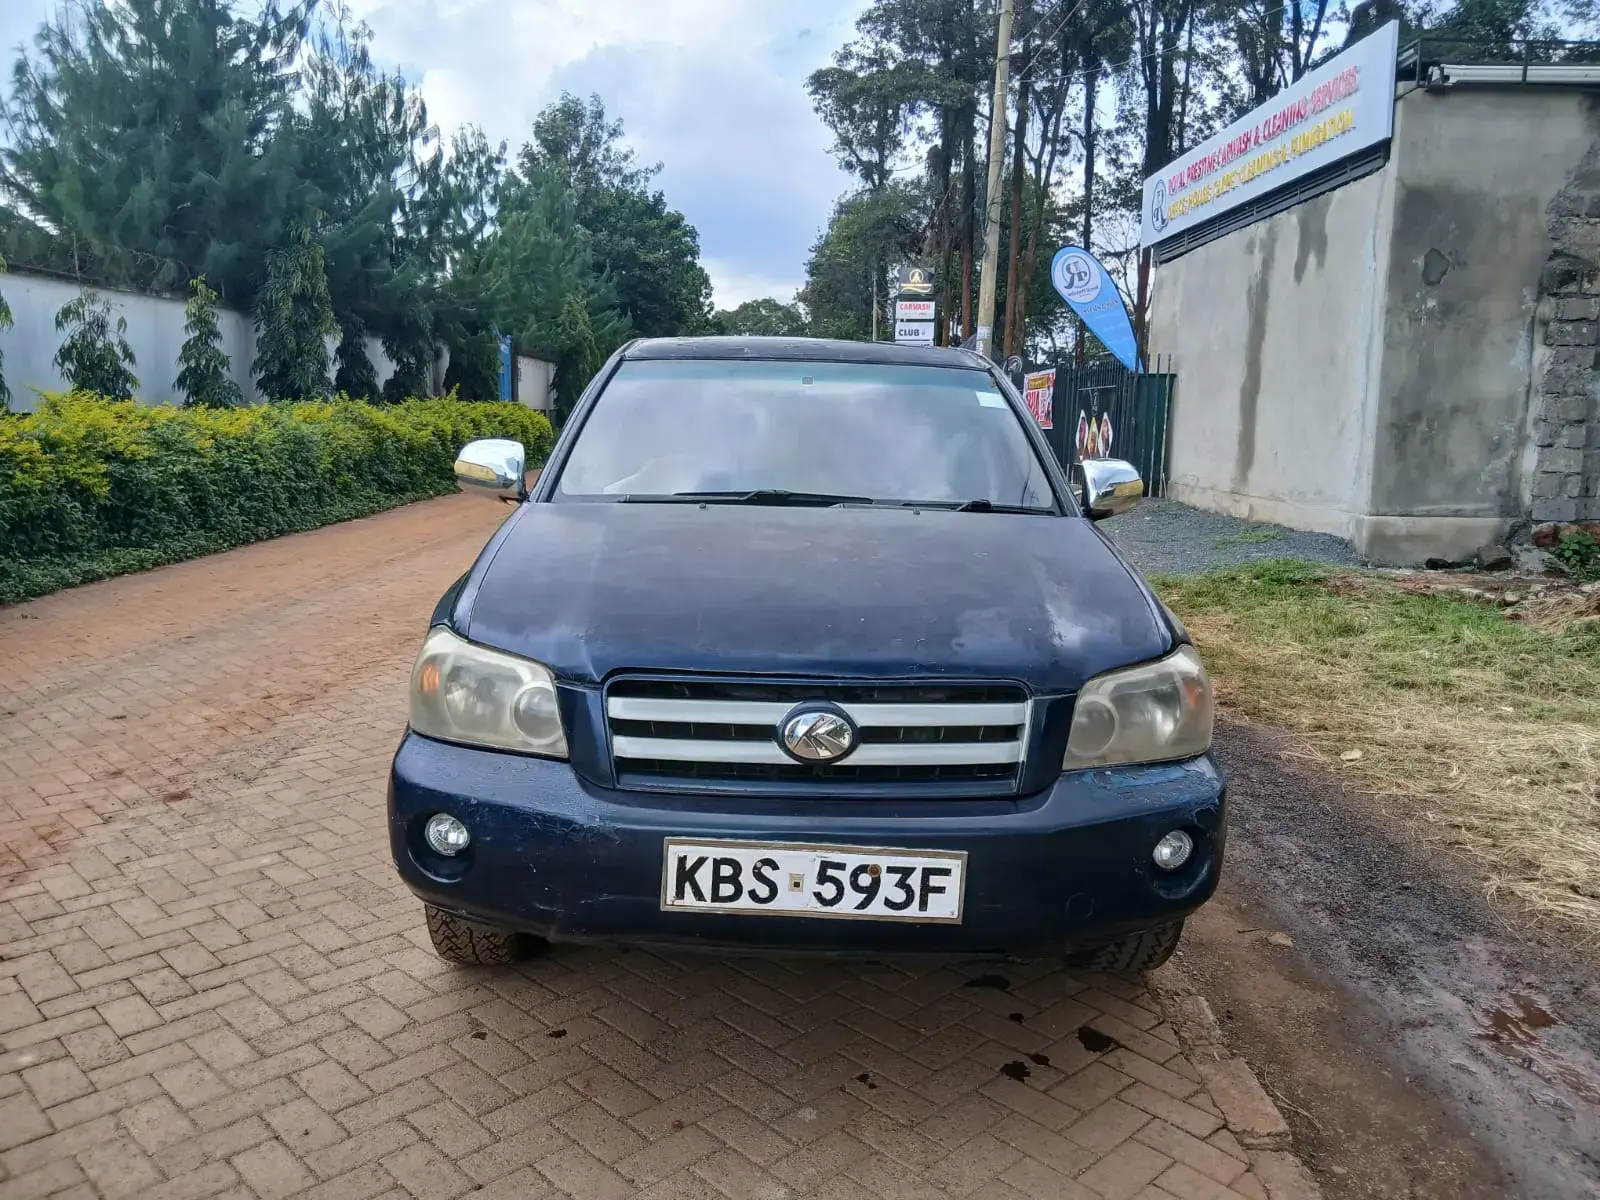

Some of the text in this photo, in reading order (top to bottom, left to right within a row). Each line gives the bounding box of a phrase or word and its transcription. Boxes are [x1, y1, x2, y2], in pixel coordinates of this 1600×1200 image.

[1168, 171, 1186, 195] ROYAL
[1217, 129, 1252, 166] CARWASH
[1254, 126, 1260, 145] &
[1263, 96, 1307, 141] CLEANING
[1311, 65, 1358, 115] SERVICES
[1290, 108, 1355, 157] FUMIGATION
[900, 303, 931, 311] CARWASH
[898, 328, 920, 337] CLUB
[674, 854, 952, 912] KBS 593F
